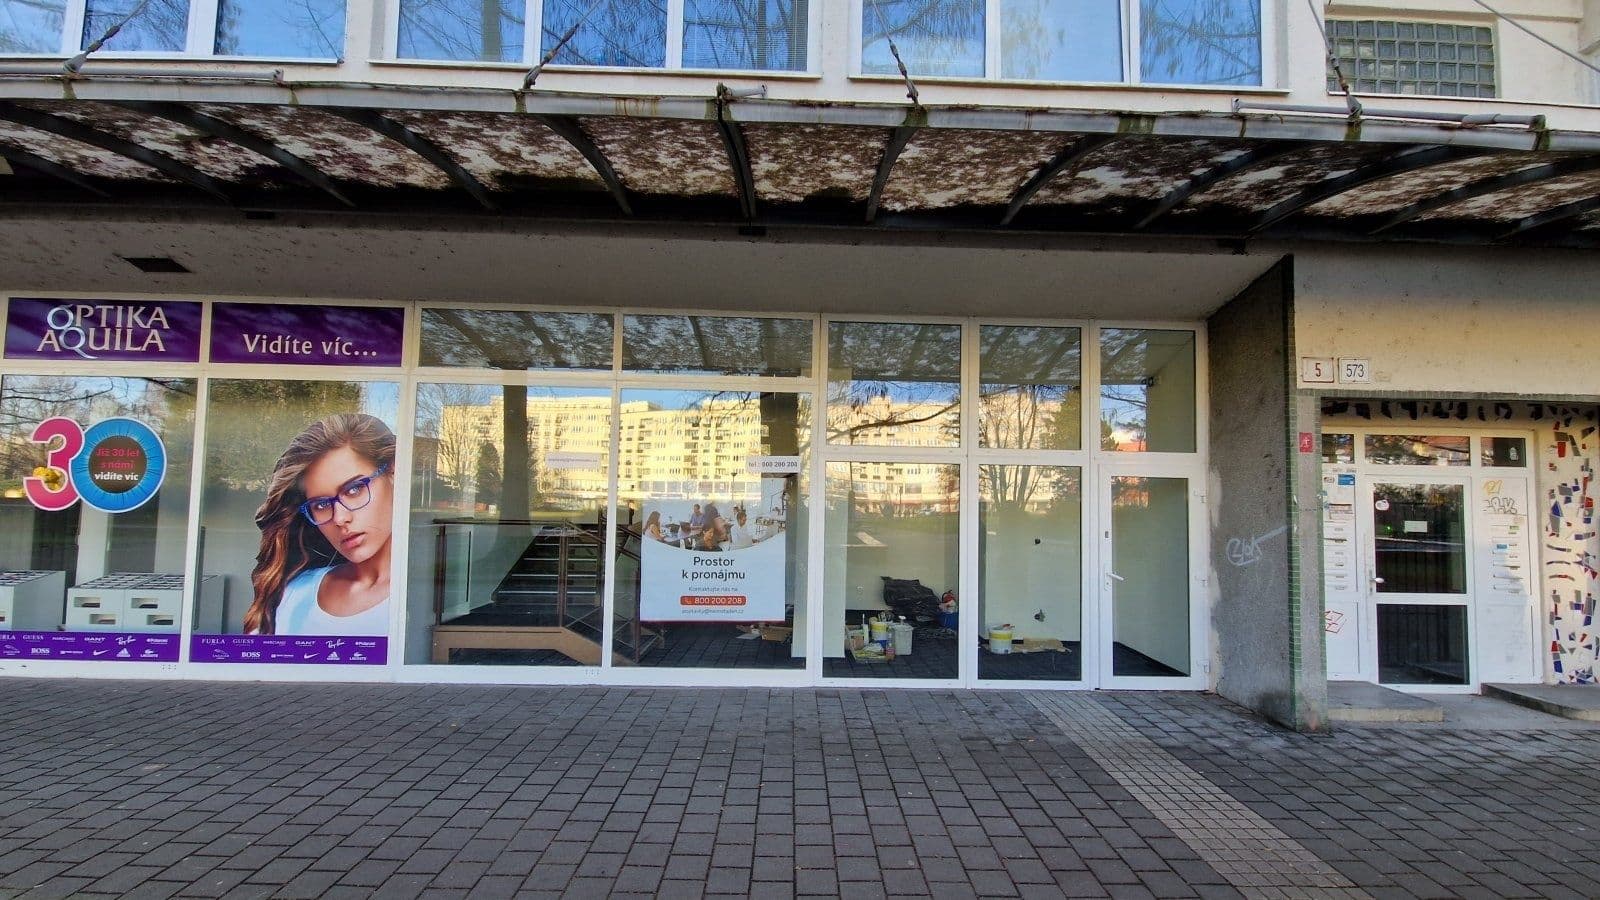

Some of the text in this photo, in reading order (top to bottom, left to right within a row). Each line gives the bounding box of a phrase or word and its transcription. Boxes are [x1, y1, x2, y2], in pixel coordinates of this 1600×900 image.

[47, 304, 170, 330] OPTIKA
[37, 327, 166, 359] AQUILA
[243, 334, 377, 357] Vidíte víc...
[1315, 362, 1321, 377] 5
[1346, 364, 1365, 378] 573
[111, 448, 125, 457] 30
[127, 448, 139, 457] let
[94, 471, 139, 481] vidíte víc
[693, 556, 735, 567] Prostor
[682, 568, 746, 582] k pronájmu
